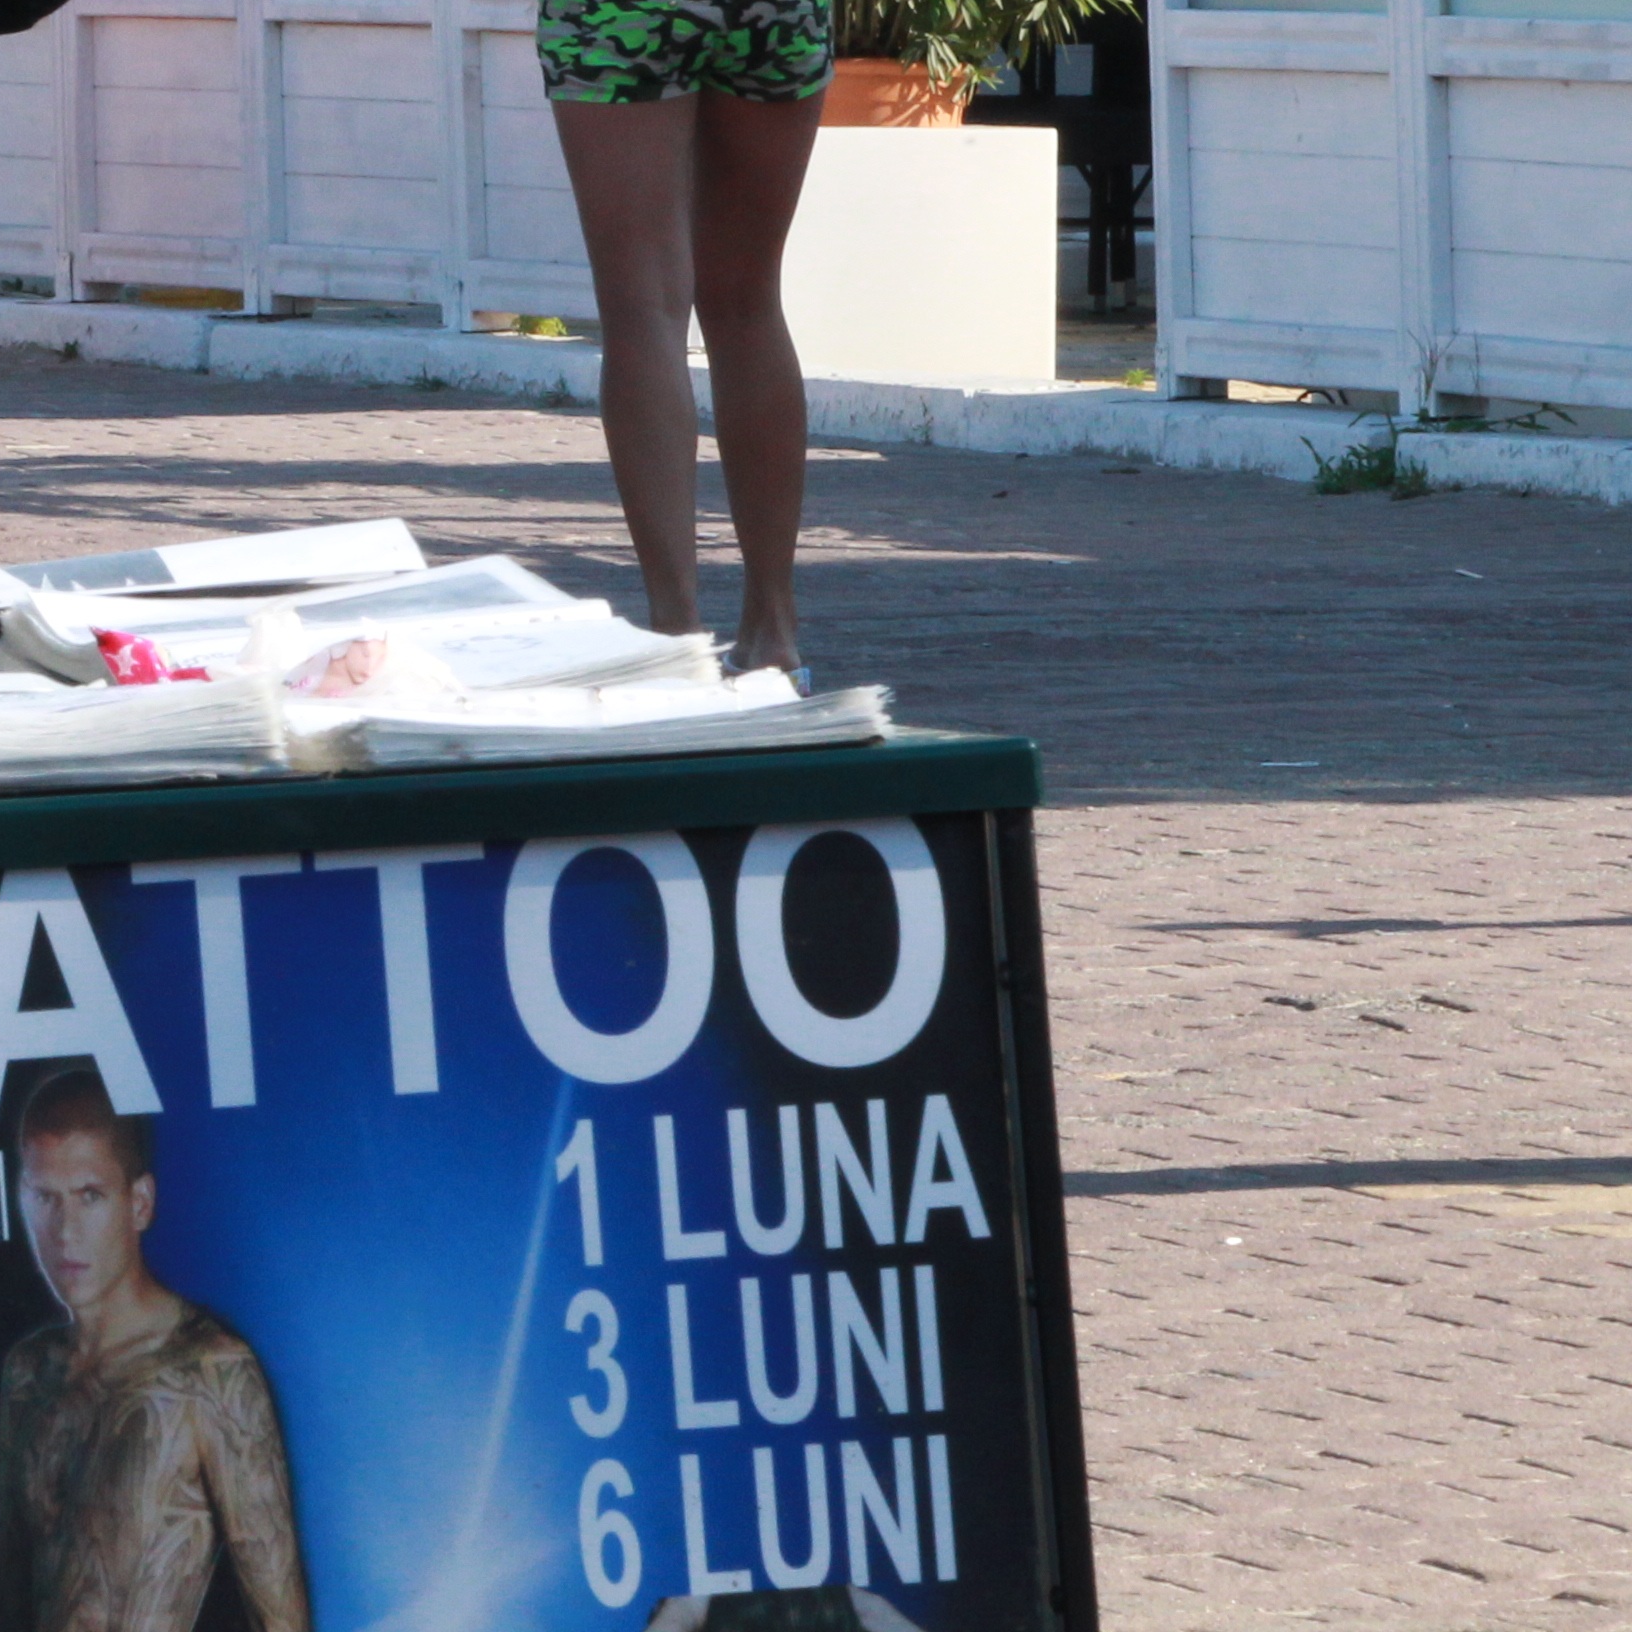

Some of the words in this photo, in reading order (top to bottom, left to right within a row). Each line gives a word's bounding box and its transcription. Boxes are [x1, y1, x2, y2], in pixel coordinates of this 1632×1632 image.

[554, 1118, 604, 1267] 1
[653, 1093, 992, 1261] LUNA
[564, 1288, 629, 1439] 3
[666, 1264, 945, 1431] LUNI
[578, 1458, 643, 1609] 6
[679, 1433, 959, 1597] LUNI
